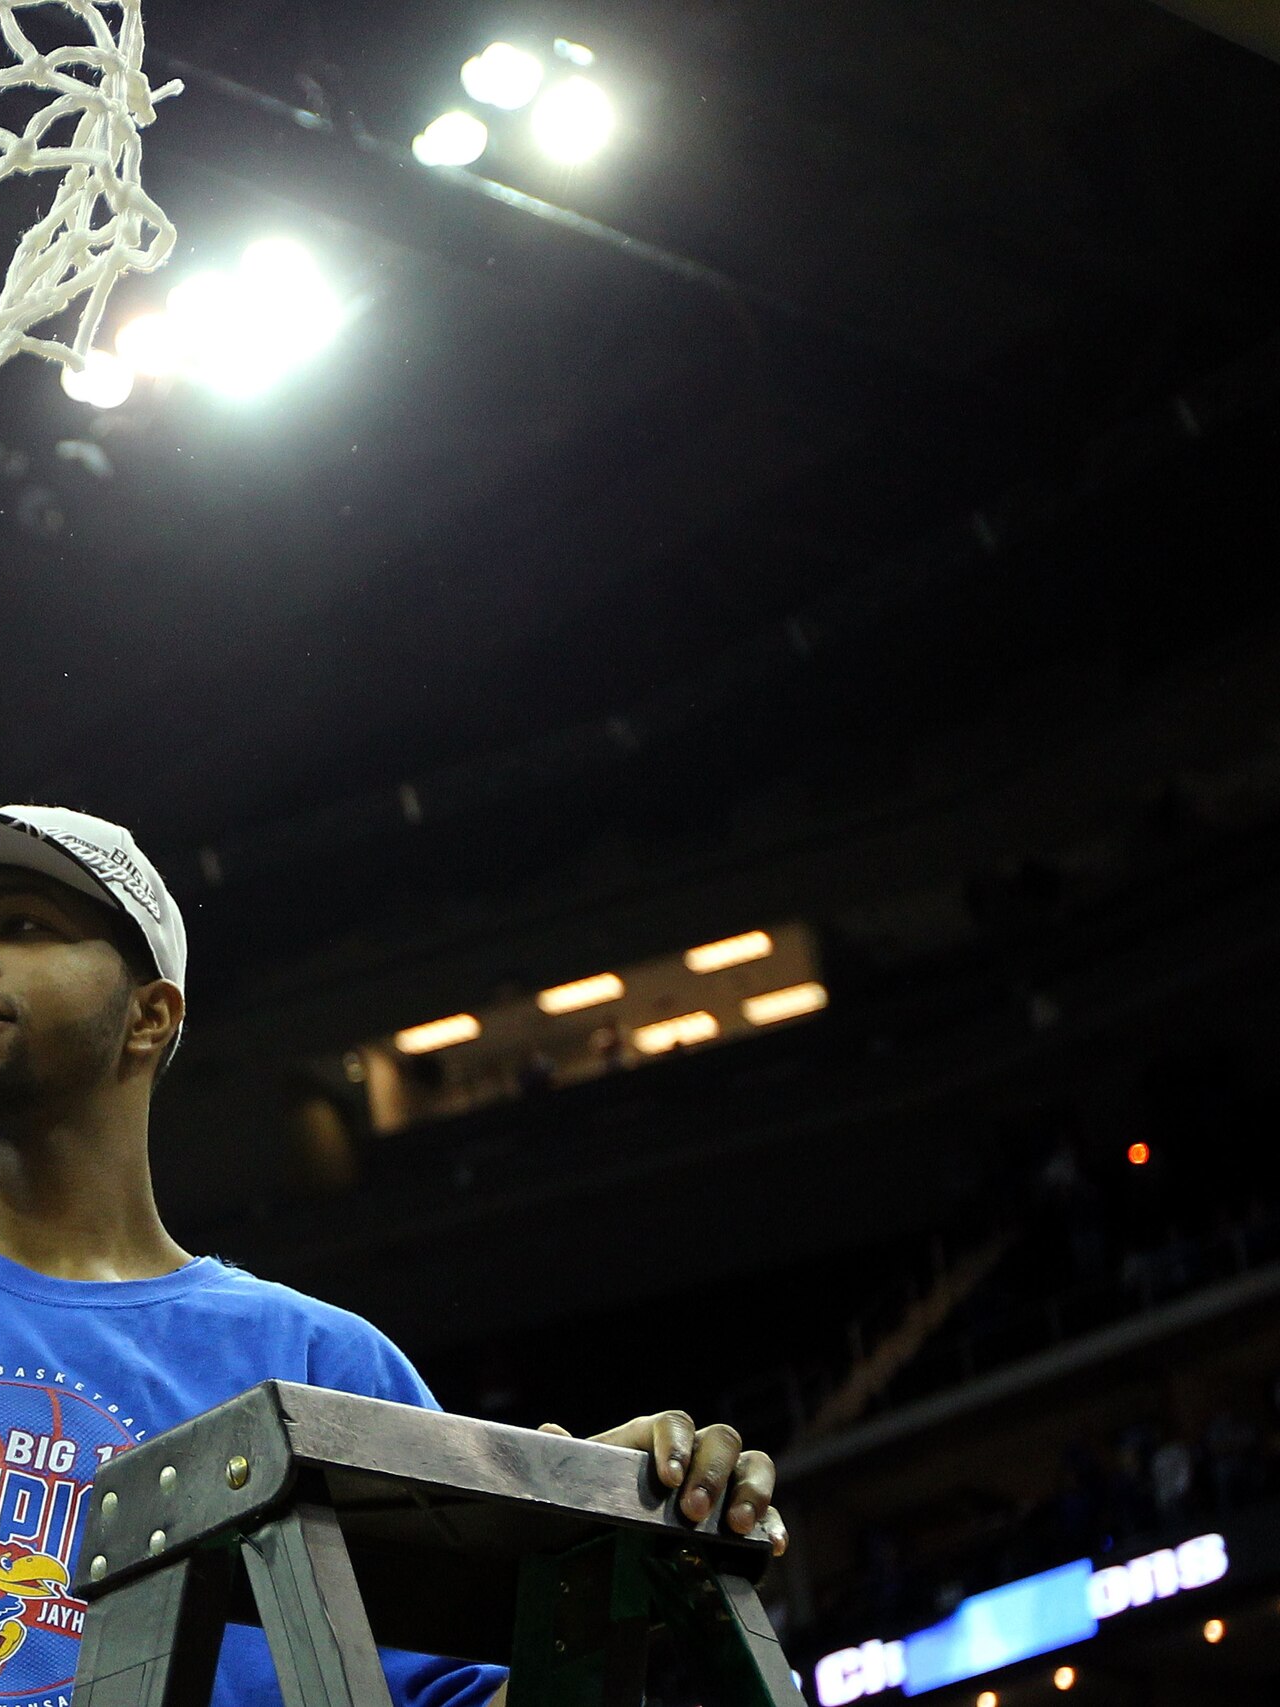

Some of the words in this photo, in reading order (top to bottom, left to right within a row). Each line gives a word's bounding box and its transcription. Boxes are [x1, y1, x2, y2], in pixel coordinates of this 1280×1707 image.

[111, 847, 144, 885] BIG
[5, 1430, 77, 1474] BIG
[96, 1445, 125, 1464] 1
[36, 1600, 85, 1635] JAYH
